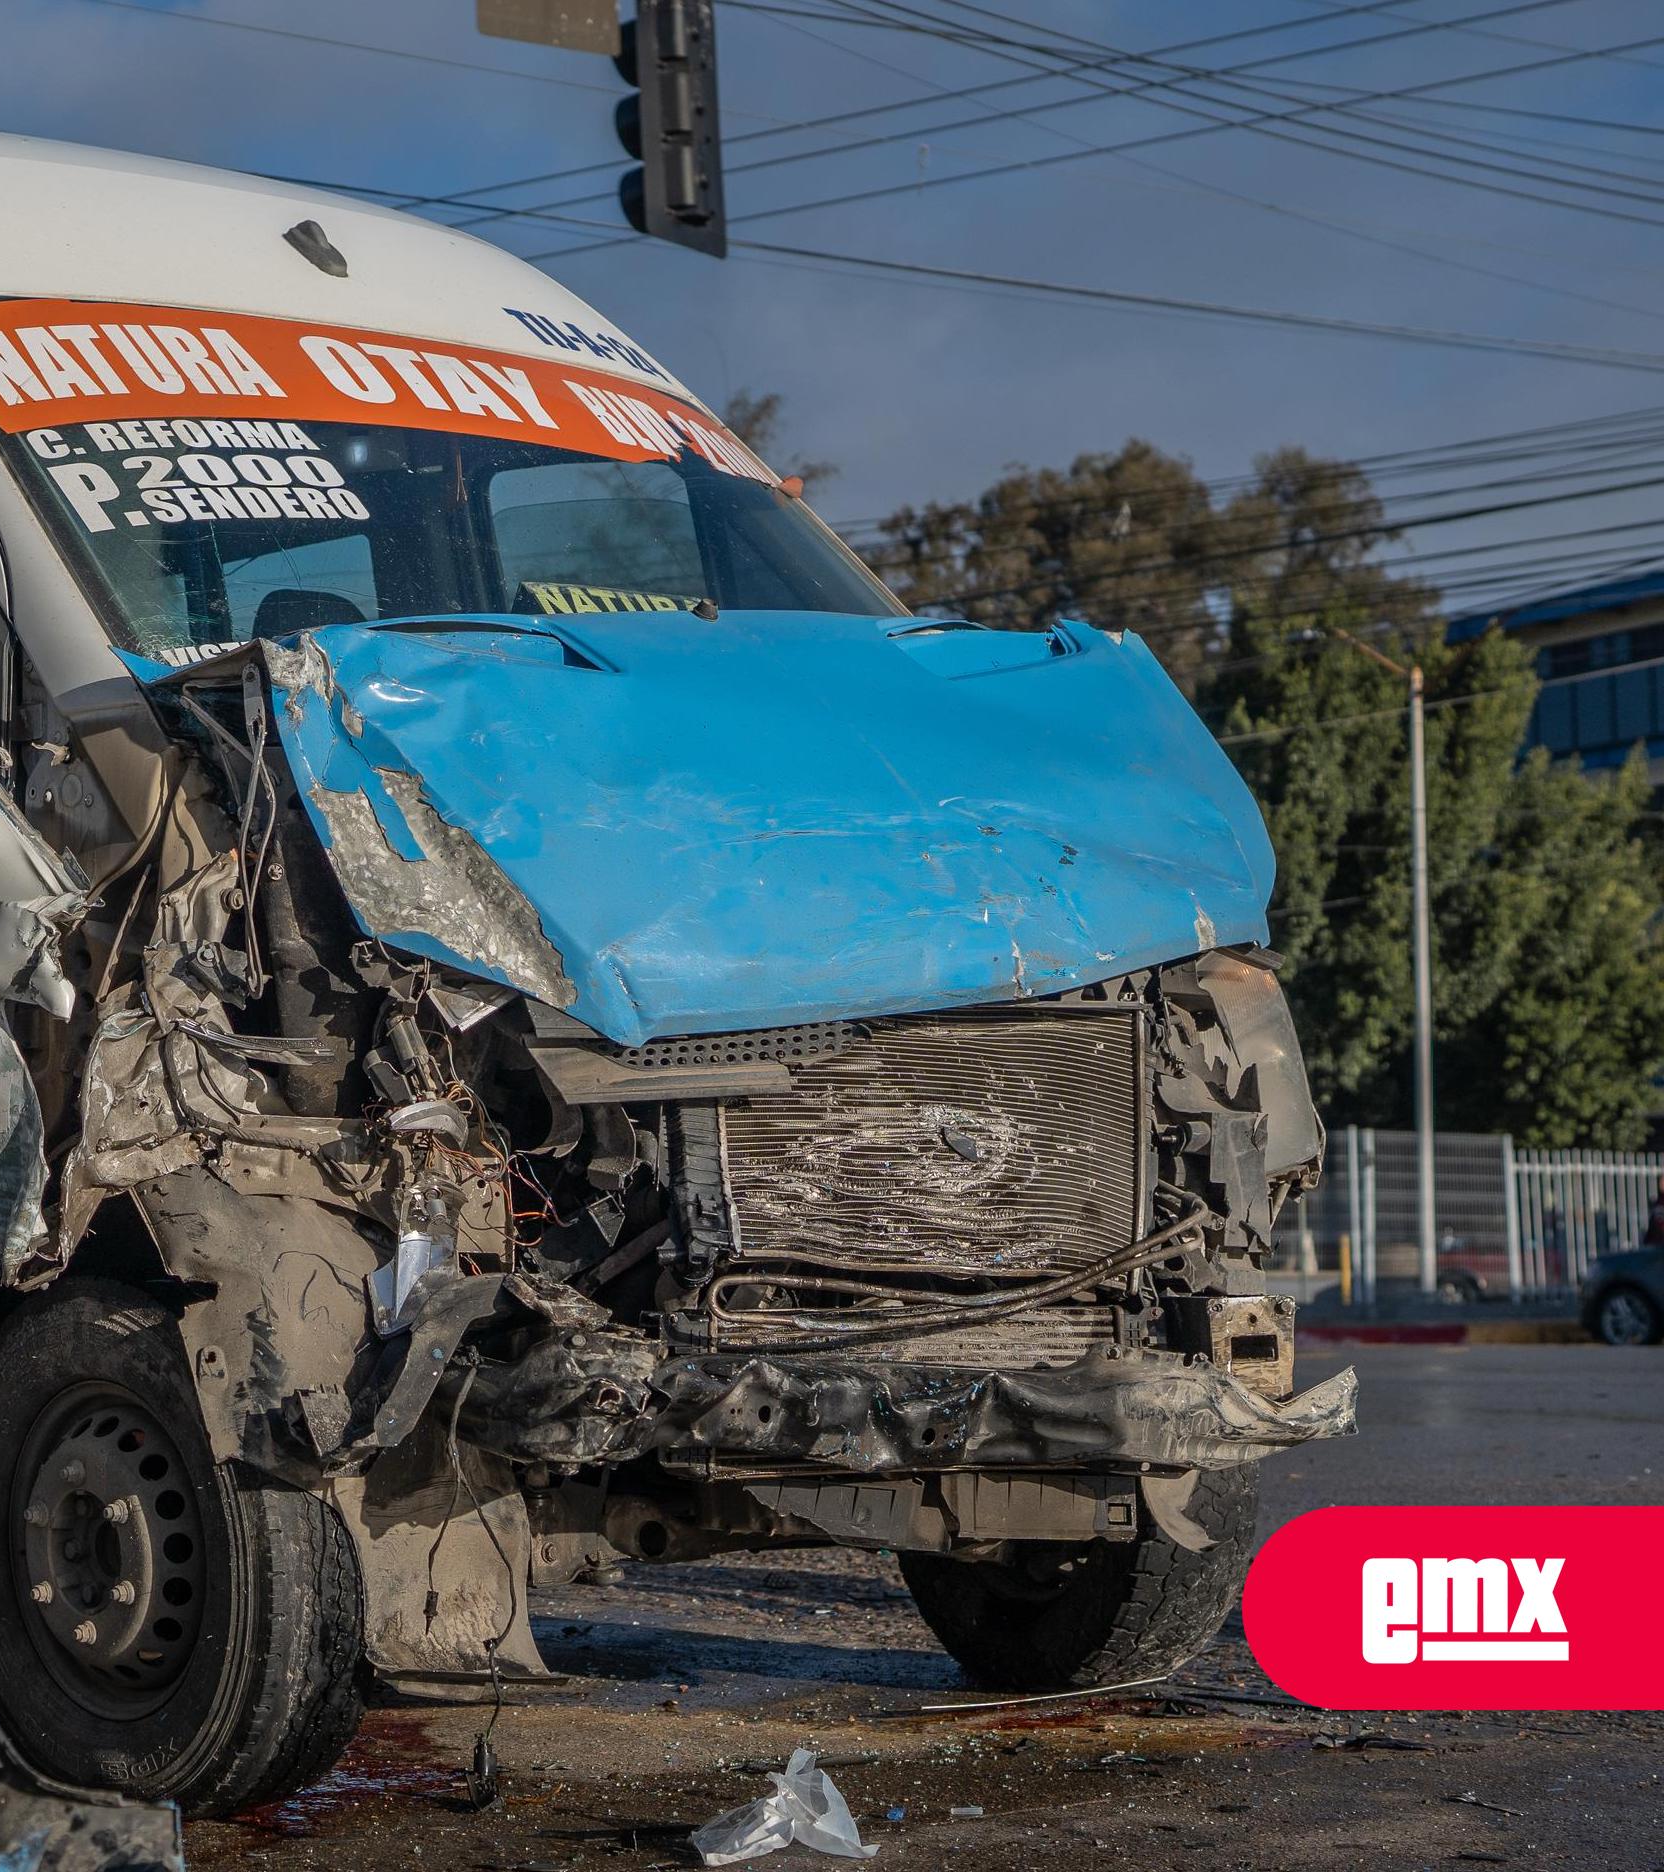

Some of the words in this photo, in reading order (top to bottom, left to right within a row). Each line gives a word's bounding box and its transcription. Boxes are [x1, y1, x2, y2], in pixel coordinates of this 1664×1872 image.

[298, 335, 560, 430] OTAY
[27, 428, 86, 459] C.
[86, 420, 320, 452] REFORMA
[47, 462, 152, 533] P.
[124, 454, 345, 490] 2000
[140, 487, 370, 523] SENDERO
[534, 584, 700, 615] NATUR
